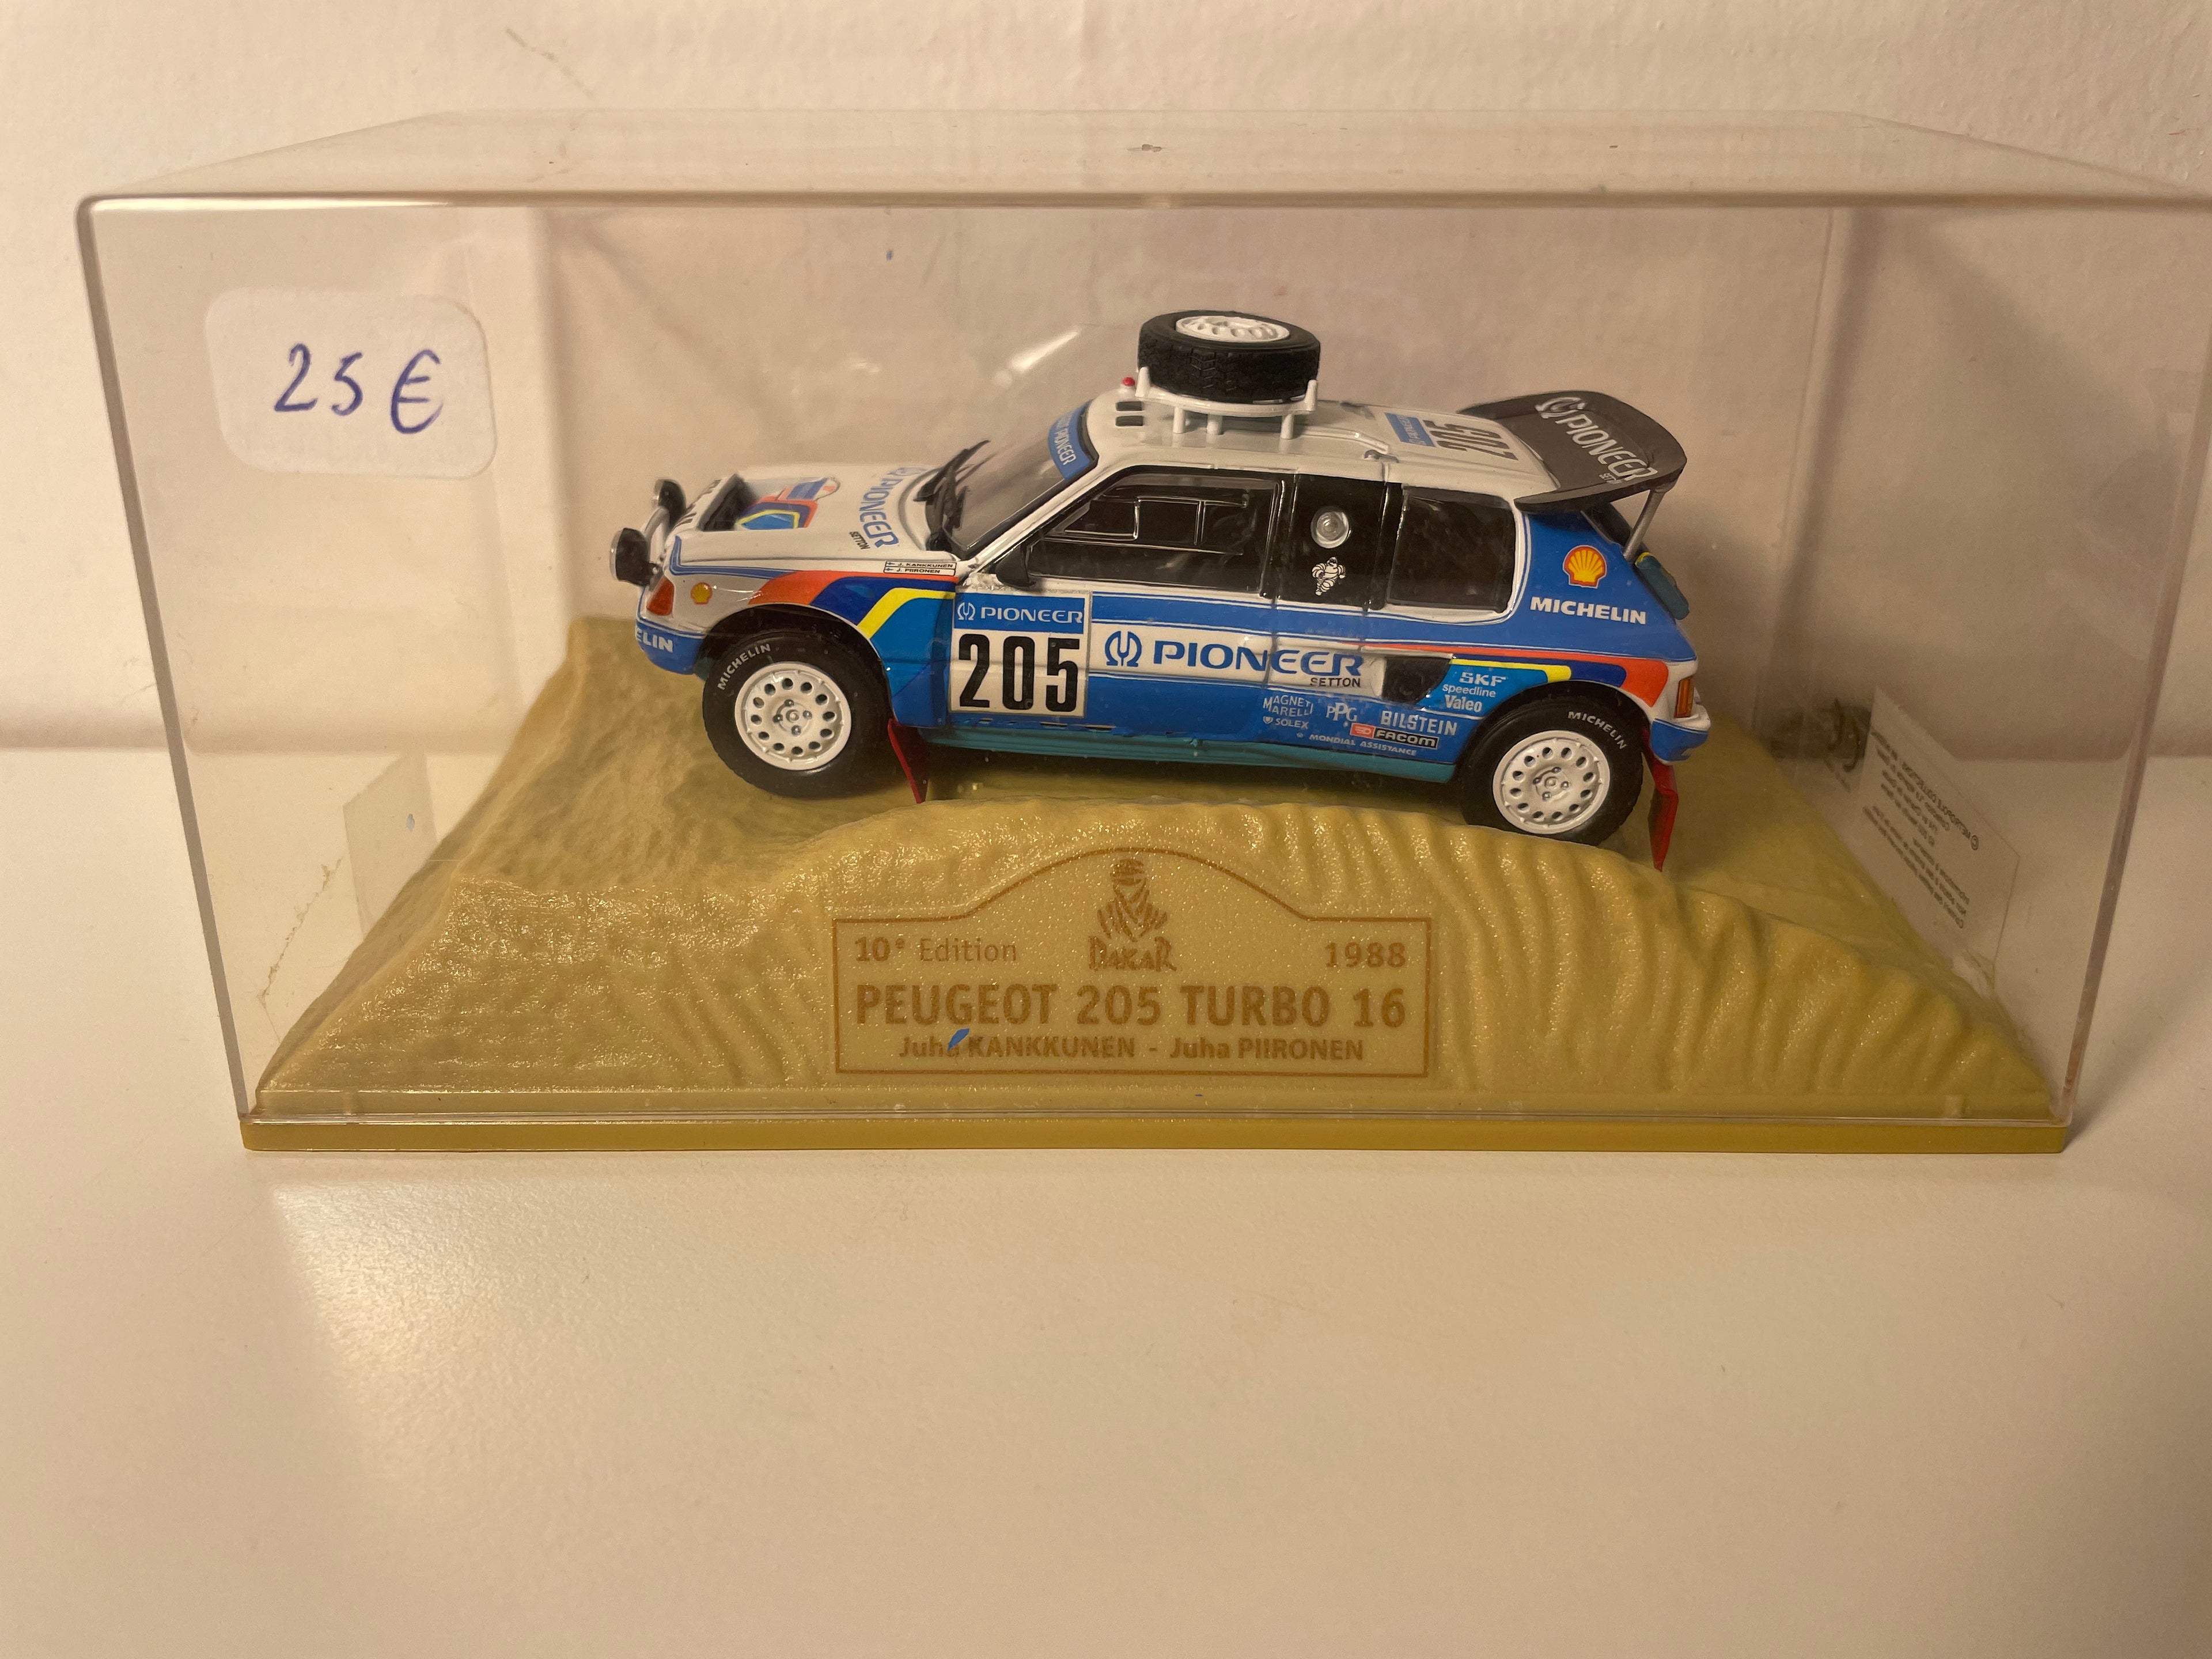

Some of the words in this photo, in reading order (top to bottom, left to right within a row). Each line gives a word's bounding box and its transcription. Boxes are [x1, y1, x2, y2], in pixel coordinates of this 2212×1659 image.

[1422, 419, 1519, 461] 205
[1555, 414, 1658, 482] PIONEER
[980, 607, 1083, 624] PIONEER
[1530, 596, 1646, 625] MICHELIN
[717, 643, 772, 691] MICHELIN
[1153, 639, 1364, 677] PIONEER
[959, 633, 1080, 712] 205
[1309, 677, 1361, 688] SETTON
[1459, 672, 1507, 687] SKF
[1442, 683, 1496, 698] speedline
[1444, 694, 1483, 713] Valeo
[1275, 718, 1309, 730] SOLEX
[1325, 702, 1358, 722] PPG
[1380, 710, 1458, 736] BILSTEIN
[1375, 729, 1436, 747] FACOM
[1567, 710, 1628, 750] MICHELIN
[1309, 734, 1356, 746] MONDIAL
[1359, 741, 1418, 756] ASSISTANCE
[921, 937, 1018, 963] Edition
[1325, 941, 1407, 968] 1988
[856, 983, 1058, 1025] PEUGEOT
[1076, 984, 1161, 1027] 205
[1179, 984, 1330, 1028] TURBO
[1353, 988, 1406, 1028] 16
[968, 1036, 1135, 1059] KANKKUNEN
[1170, 1037, 1230, 1060] Juha
[1238, 1039, 1363, 1060] PIIRONEN
